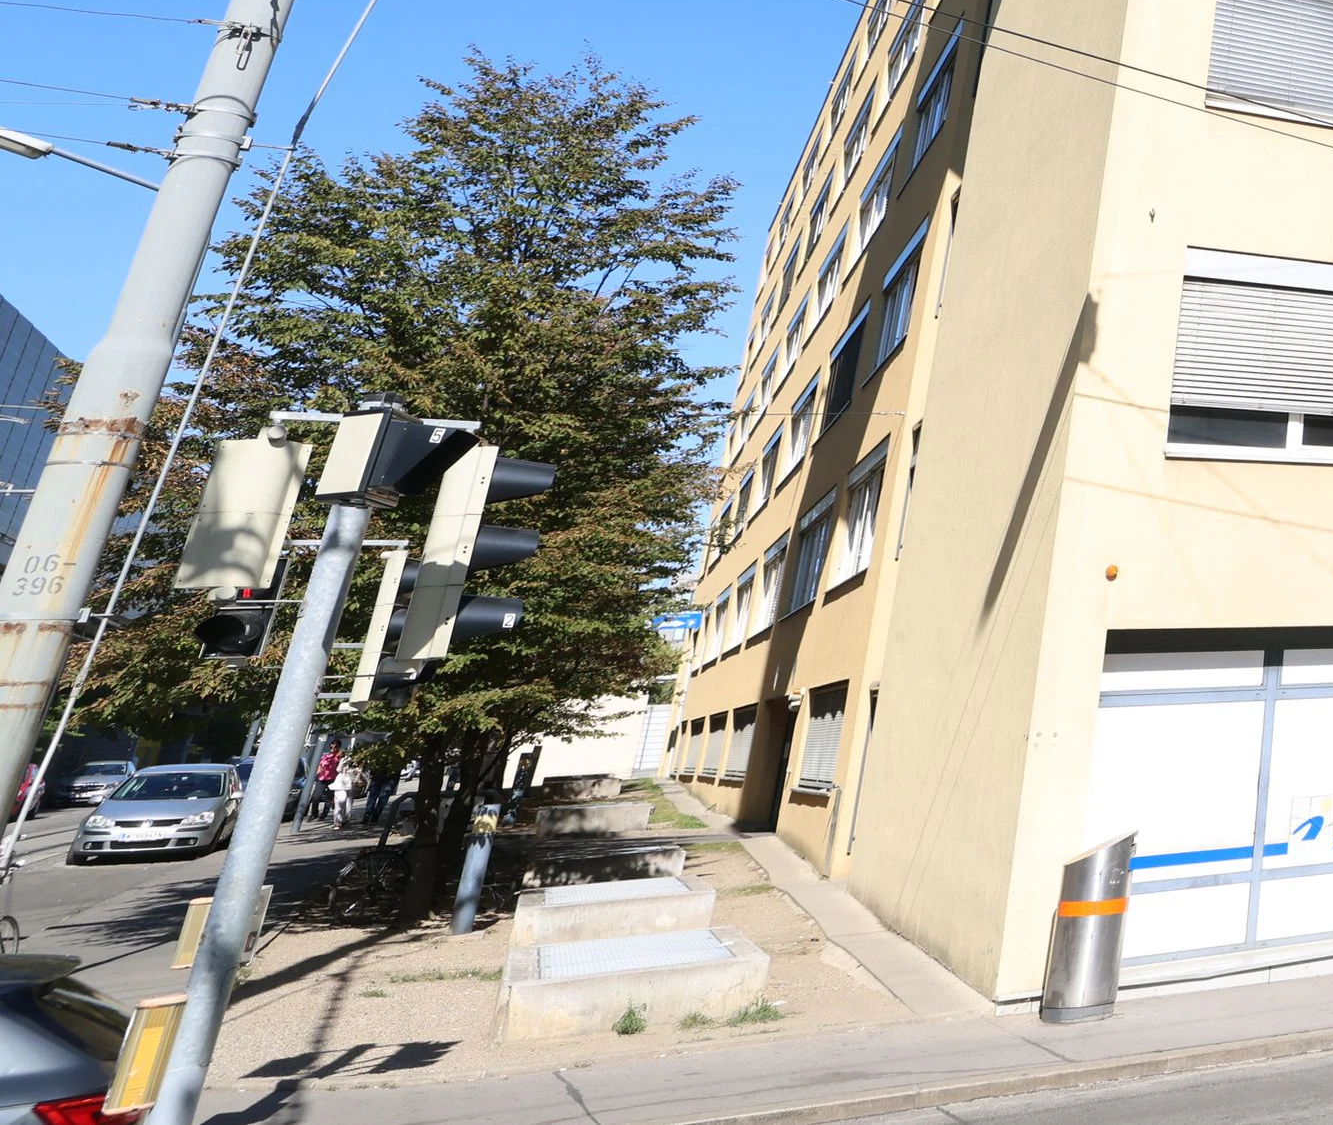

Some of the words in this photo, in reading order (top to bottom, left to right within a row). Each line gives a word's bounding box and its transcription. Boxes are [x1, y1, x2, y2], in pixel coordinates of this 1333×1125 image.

[431, 428, 444, 443] 5
[12, 576, 65, 596] 396
[504, 614, 515, 627] 2
